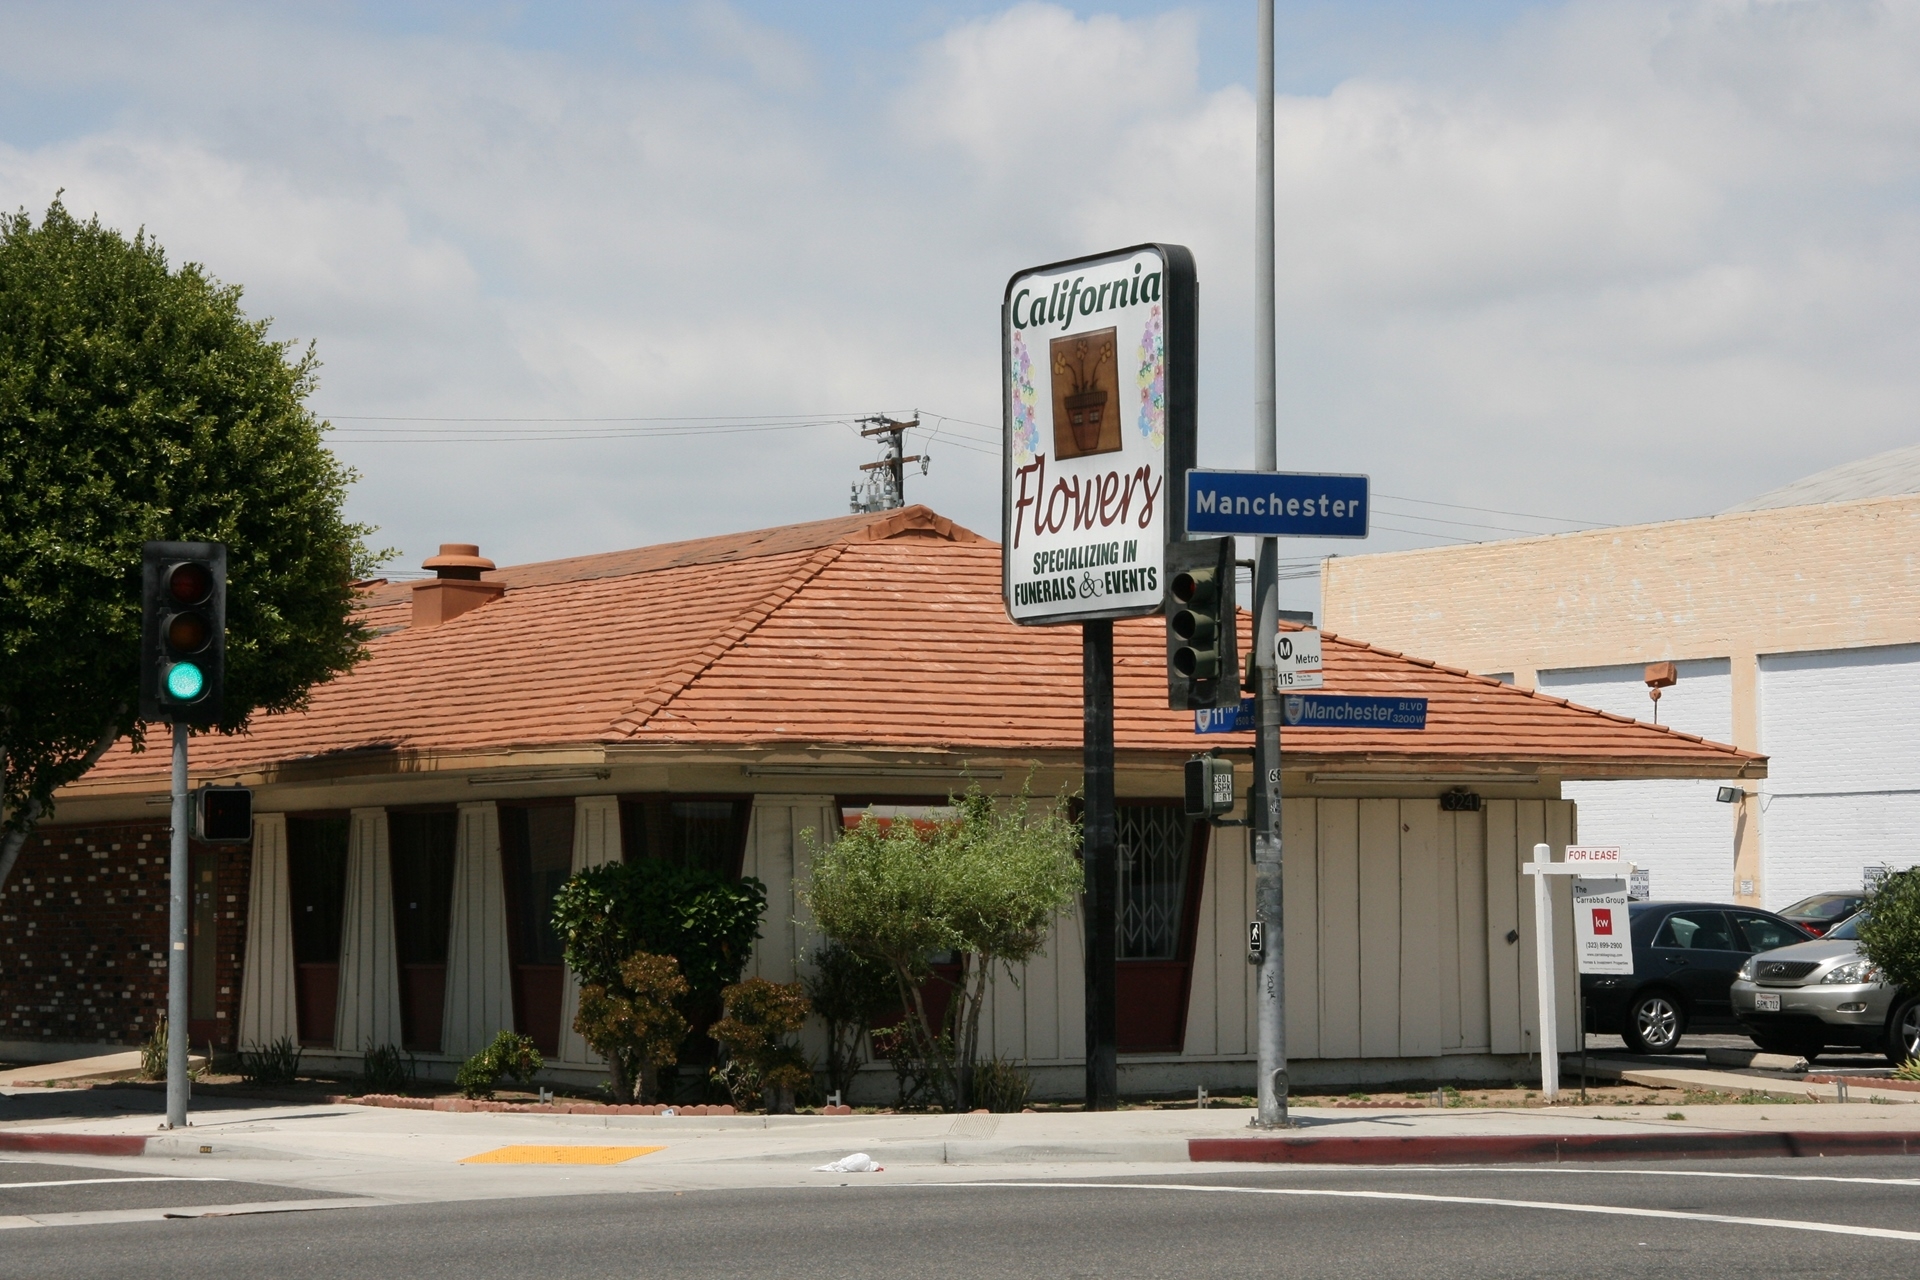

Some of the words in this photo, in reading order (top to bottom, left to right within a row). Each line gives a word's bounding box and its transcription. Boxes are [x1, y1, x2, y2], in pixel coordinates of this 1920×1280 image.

[1012, 262, 1162, 331] California
[1014, 452, 1163, 550] Flowers
[1196, 489, 1360, 518] Manchester
[1033, 541, 1119, 575] SPECIALIZING
[1122, 539, 1138, 563] IN
[1014, 576, 1077, 607] FUNERALS
[1079, 571, 1104, 599] &
[1104, 566, 1158, 595] EVENTS
[1295, 654, 1320, 665] Metro
[1279, 672, 1294, 685] 115
[1212, 707, 1224, 725] 11
[1304, 701, 1394, 721] Manchester
[1399, 702, 1423, 711] BLVD
[1568, 850, 1587, 860] FOR
[1589, 850, 1618, 860] LEASE
[1574, 885, 1587, 893] The
[1576, 896, 1605, 904] Carrabba
[1605, 896, 1625, 906] Group
[1595, 916, 1609, 927] kw
